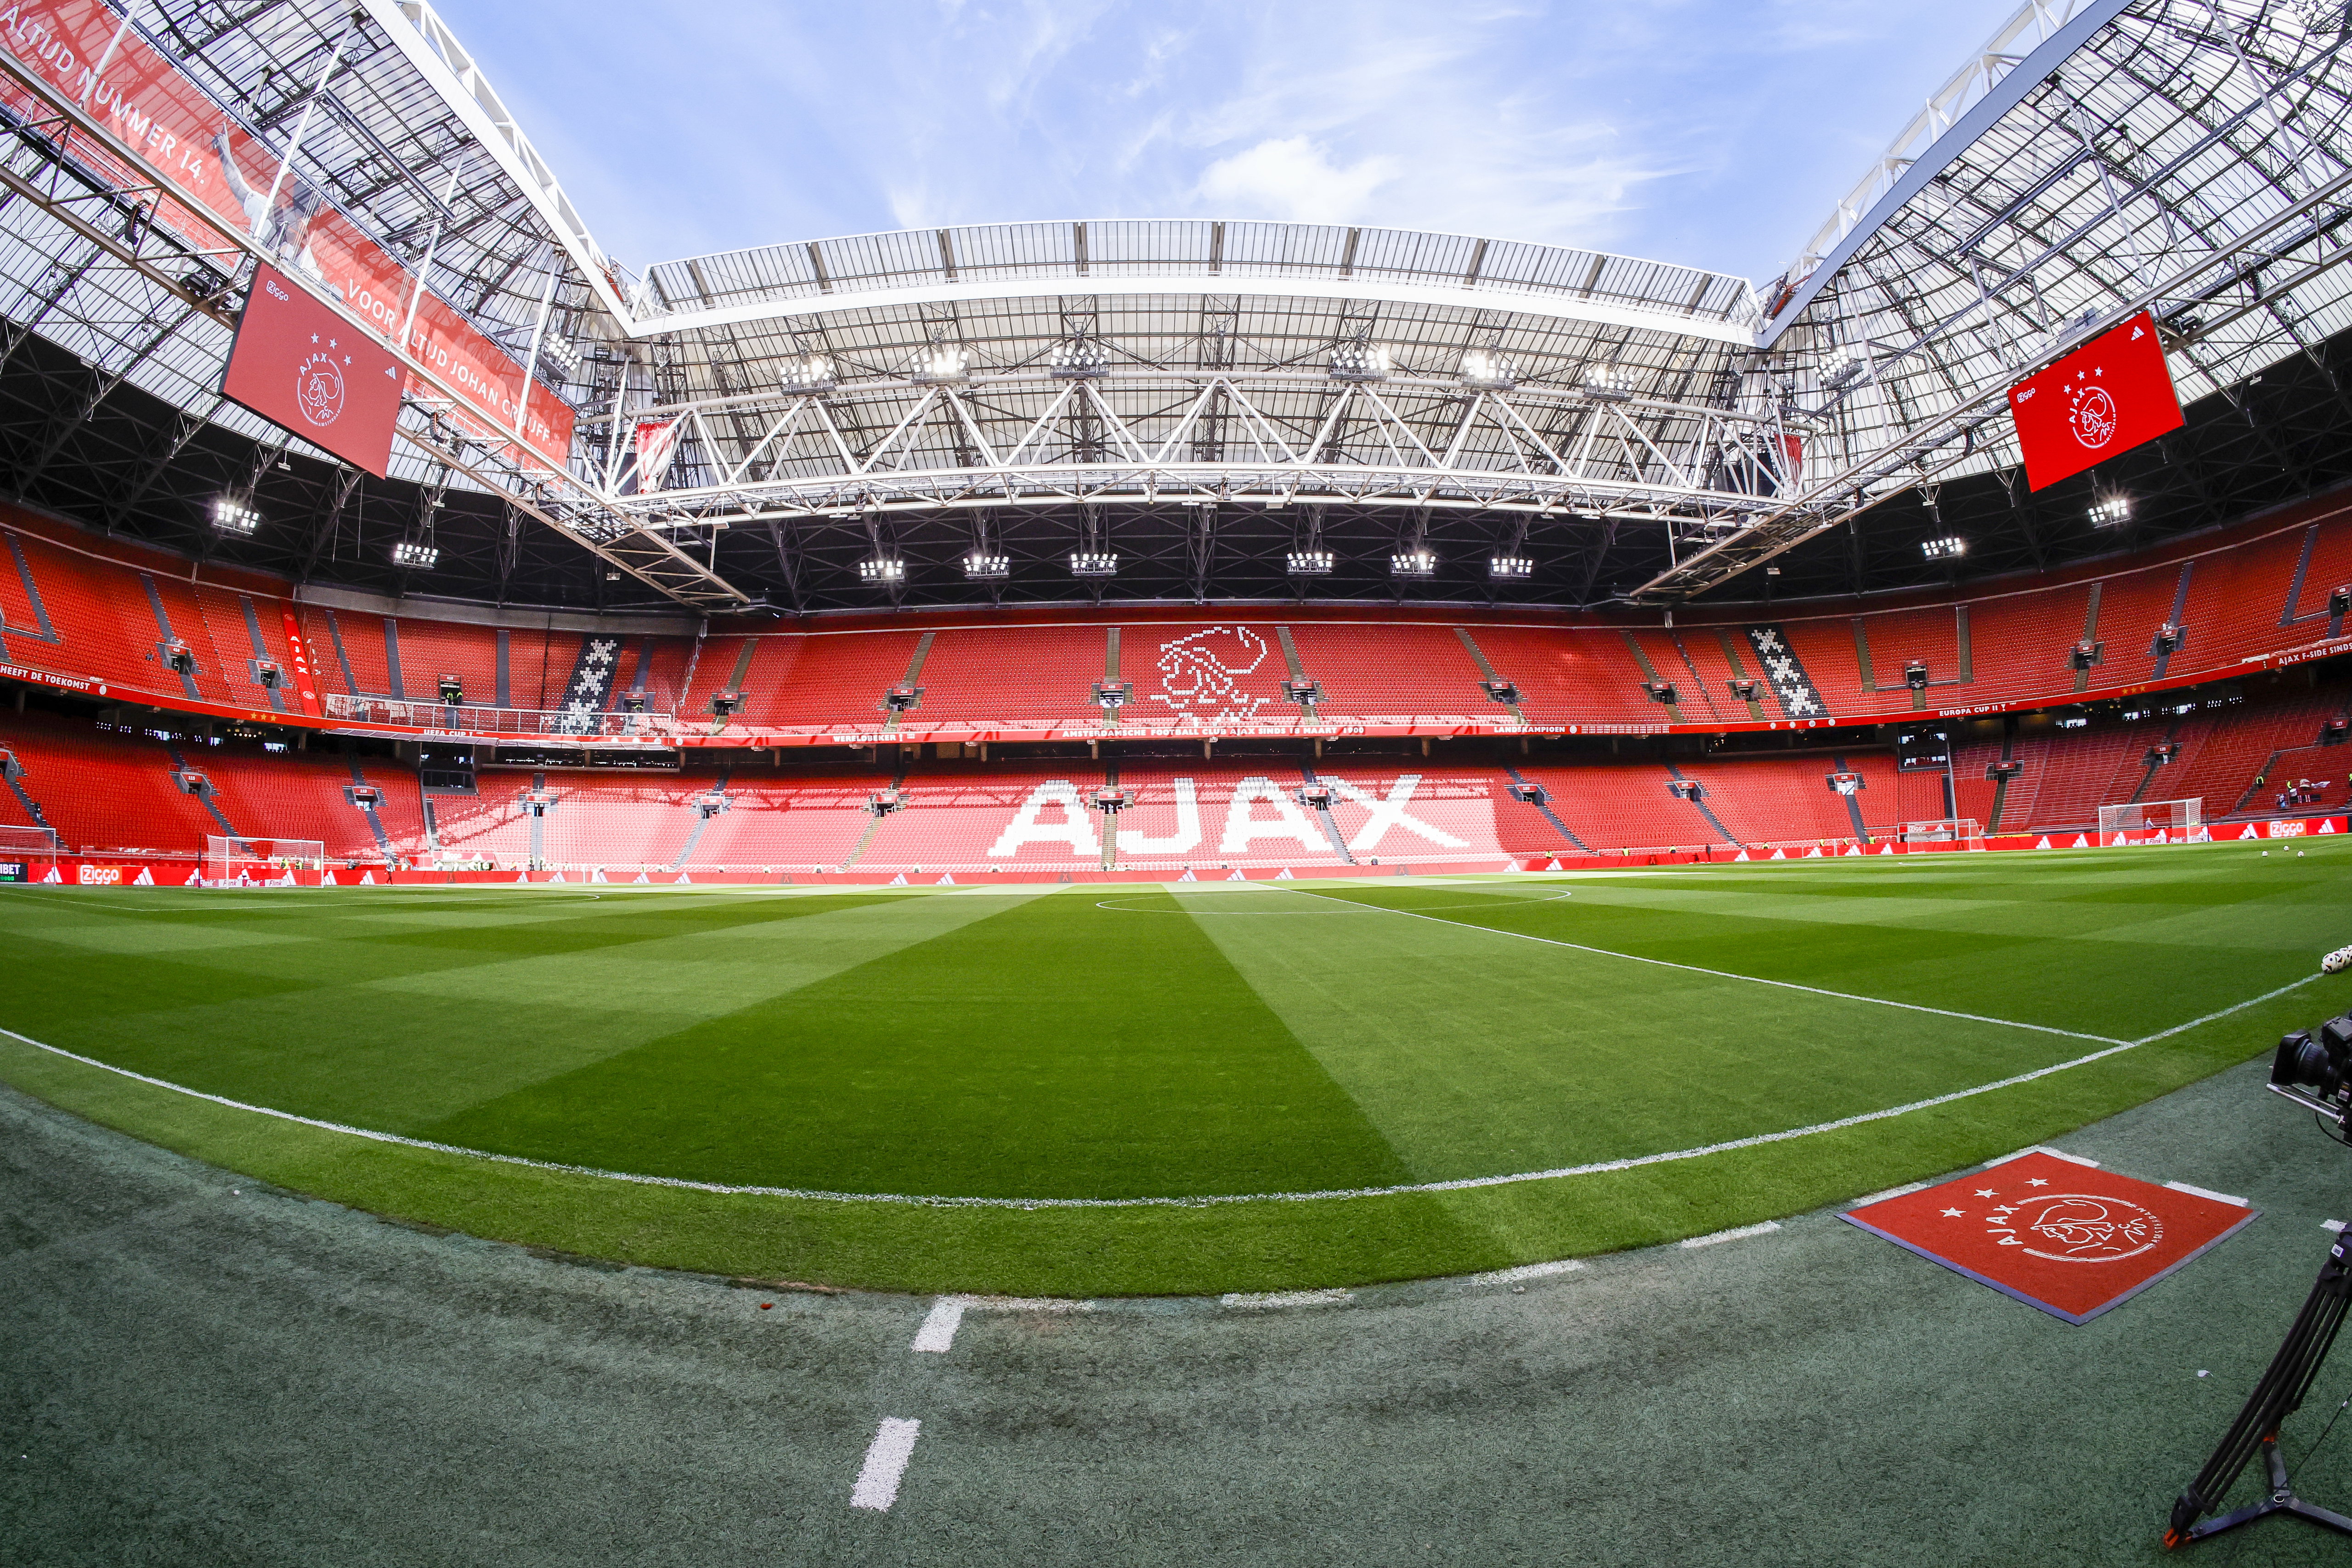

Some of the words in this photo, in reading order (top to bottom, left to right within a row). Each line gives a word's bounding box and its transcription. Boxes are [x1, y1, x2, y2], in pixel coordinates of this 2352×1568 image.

[0, 6, 74, 72] ALTIJD
[180, 150, 205, 184] 14.
[266, 280, 289, 301] Ziggo
[349, 278, 396, 329] VOOR
[450, 361, 498, 406] JOHAN
[299, 352, 327, 376] AJAX
[2017, 388, 2035, 403] Ziggo
[2069, 388, 2085, 423] AJAX
[318, 409, 341, 427] AMSTERDAM
[2104, 413, 2116, 444] AMSTERDAM
[290, 636, 308, 674] AJAX
[2278, 654, 2300, 665] AJAX
[2302, 648, 2327, 659] F-SIDE
[0, 665, 28, 678] HEEFT
[31, 672, 42, 681] DE
[45, 674, 90, 690] TOEKOMST
[1939, 708, 1972, 716] EUROPA
[1230, 728, 1255, 736] AJAX
[988, 776, 1471, 856] AJAX
[2270, 821, 2304, 838] Ziggo
[80, 865, 119, 884] Ziggo
[1986, 1205, 2024, 1245] AJAX
